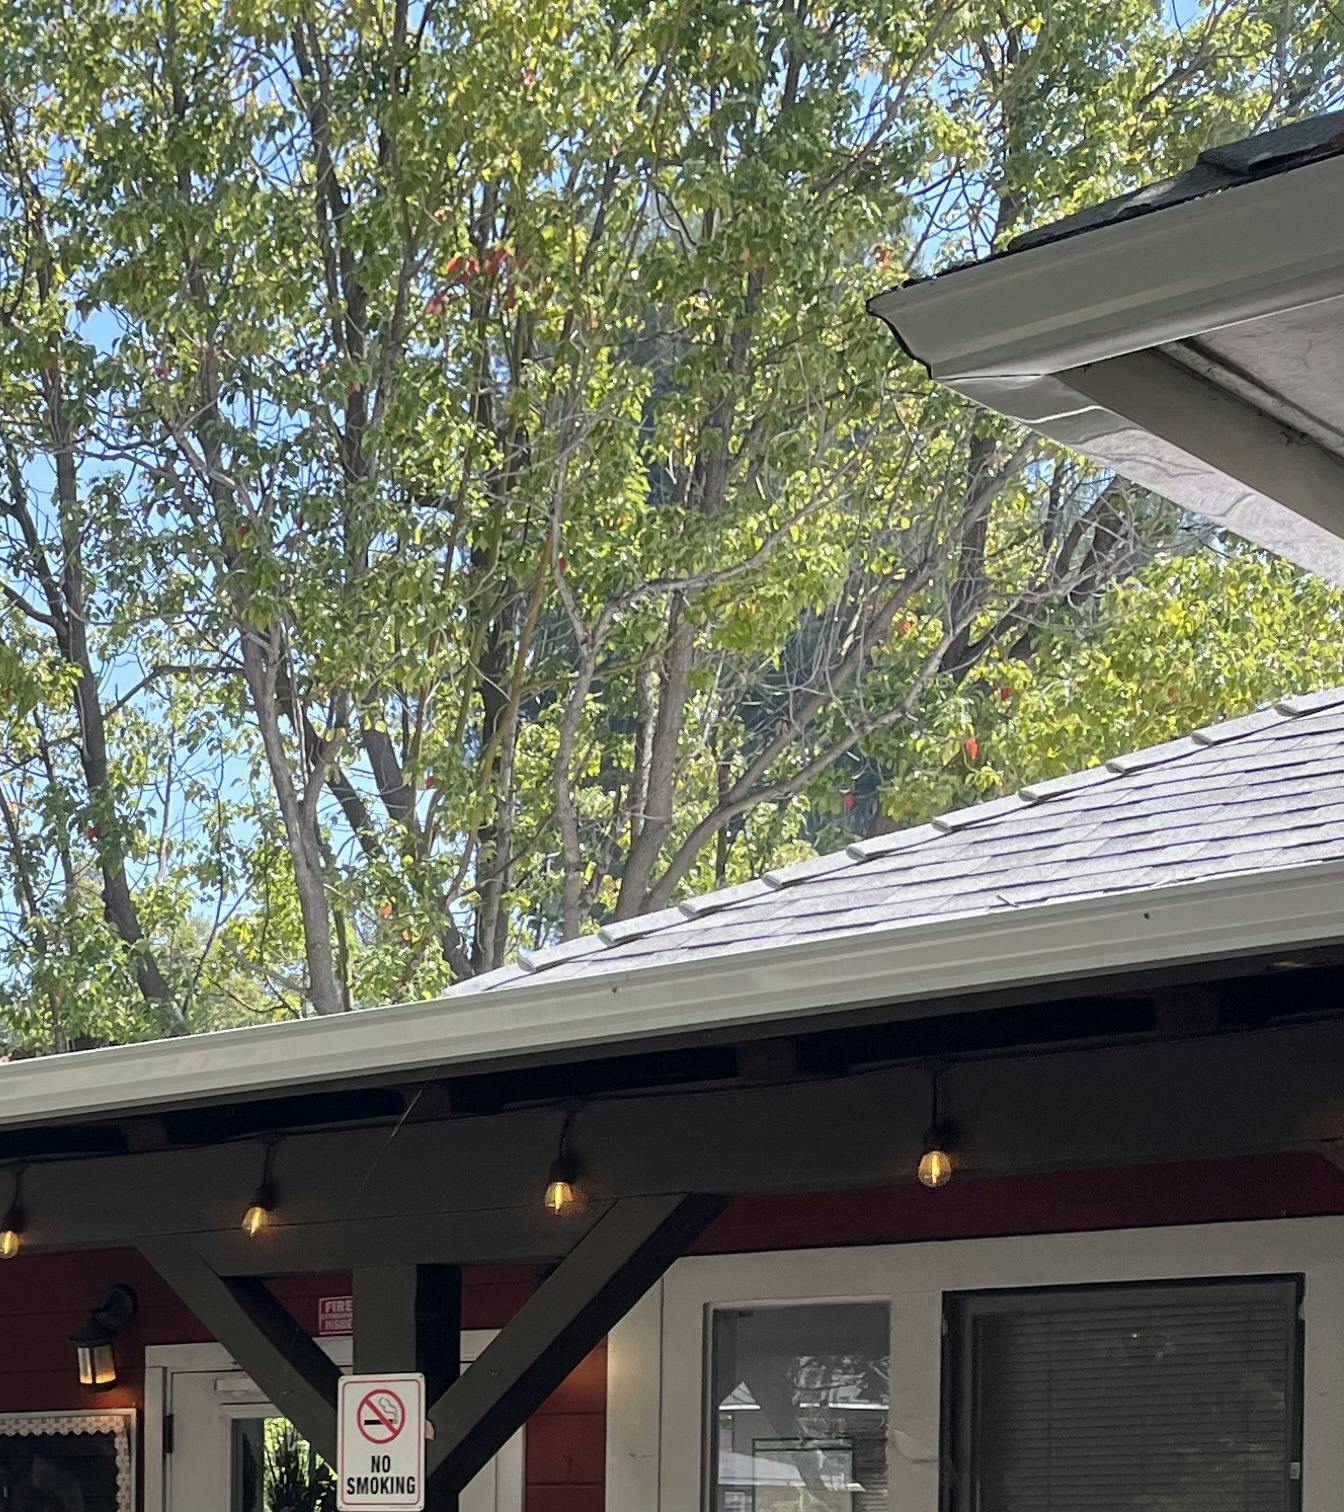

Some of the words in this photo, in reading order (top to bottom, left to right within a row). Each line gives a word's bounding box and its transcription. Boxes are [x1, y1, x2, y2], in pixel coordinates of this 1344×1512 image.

[325, 1300, 352, 1312] FIRE
[371, 1455, 391, 1473] NO
[347, 1476, 415, 1495] SMOKING
